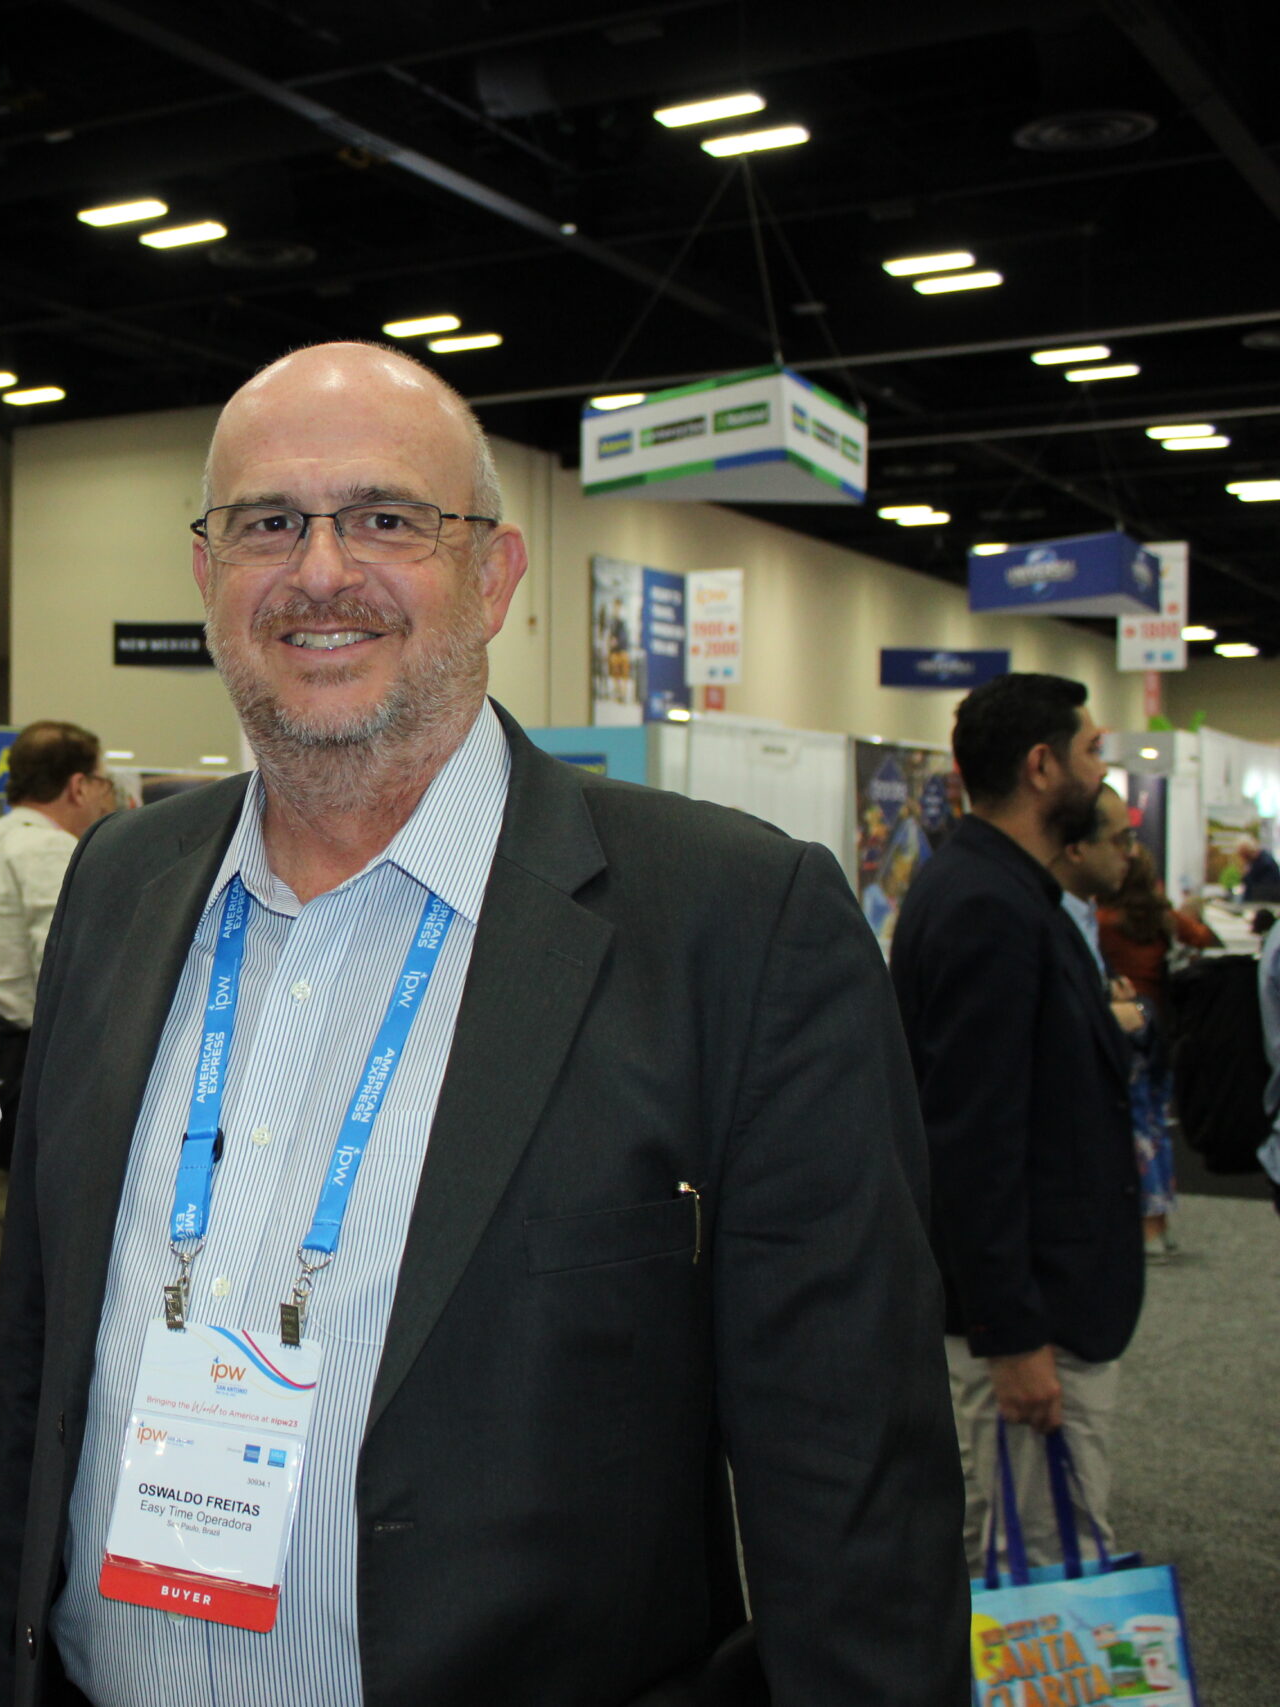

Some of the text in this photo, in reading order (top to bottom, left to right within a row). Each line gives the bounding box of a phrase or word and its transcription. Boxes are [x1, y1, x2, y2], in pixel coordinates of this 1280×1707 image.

[196, 1032, 215, 1103] AMERICAN
[207, 1032, 225, 1094] EXPRESS
[351, 1056, 382, 1121] EXPRESS
[361, 1047, 395, 1123] AMERICAN
[210, 1356, 246, 1382] ipw
[146, 1395, 177, 1408] Bringing
[178, 1401, 190, 1409] the
[191, 1400, 219, 1415] World
[219, 1408, 227, 1416] to
[229, 1410, 259, 1421] America
[270, 1417, 298, 1428] #ipw23
[136, 1421, 168, 1444] ipw
[138, 1482, 261, 1517] OSWALDO FREITAS
[140, 1499, 252, 1532] Easy Time Operadora
[202, 1526, 220, 1537] Brazil
[161, 1585, 212, 1606] BUYER
